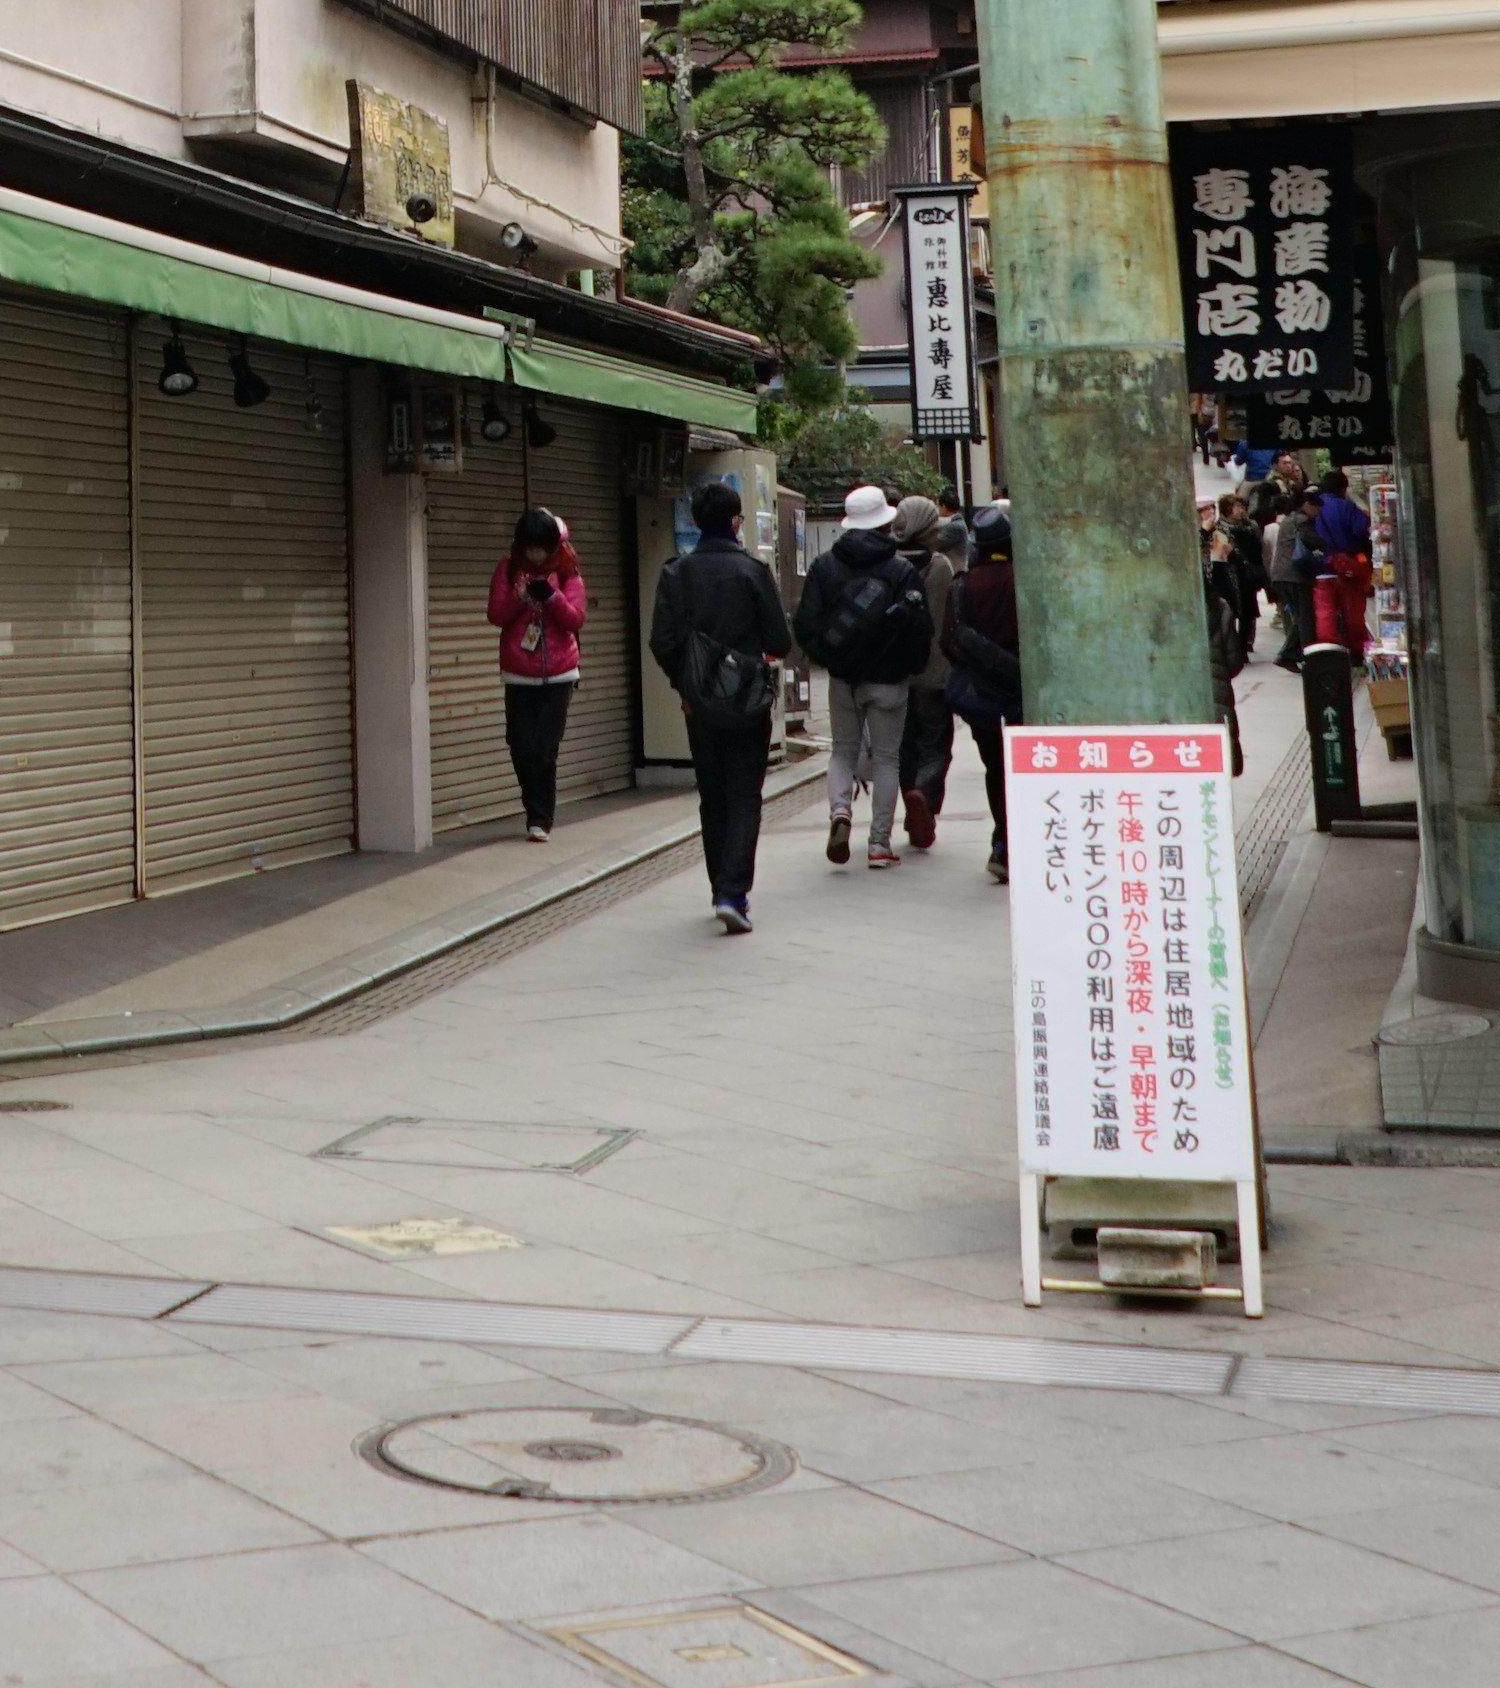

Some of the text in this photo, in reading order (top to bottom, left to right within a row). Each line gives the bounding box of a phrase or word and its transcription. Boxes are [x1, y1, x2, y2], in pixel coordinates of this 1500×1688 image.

[1213, 348, 1319, 383] 丸だい
[1269, 164, 1333, 334] 海産物
[1030, 740, 1203, 770] お知らせ
[1080, 788, 1121, 1153] ポケモンGOの利用はご遠慮
[1115, 789, 1159, 1156] 午後10時から深夜・早朝まで
[1156, 788, 1199, 1154] この周辺は住居地域のため
